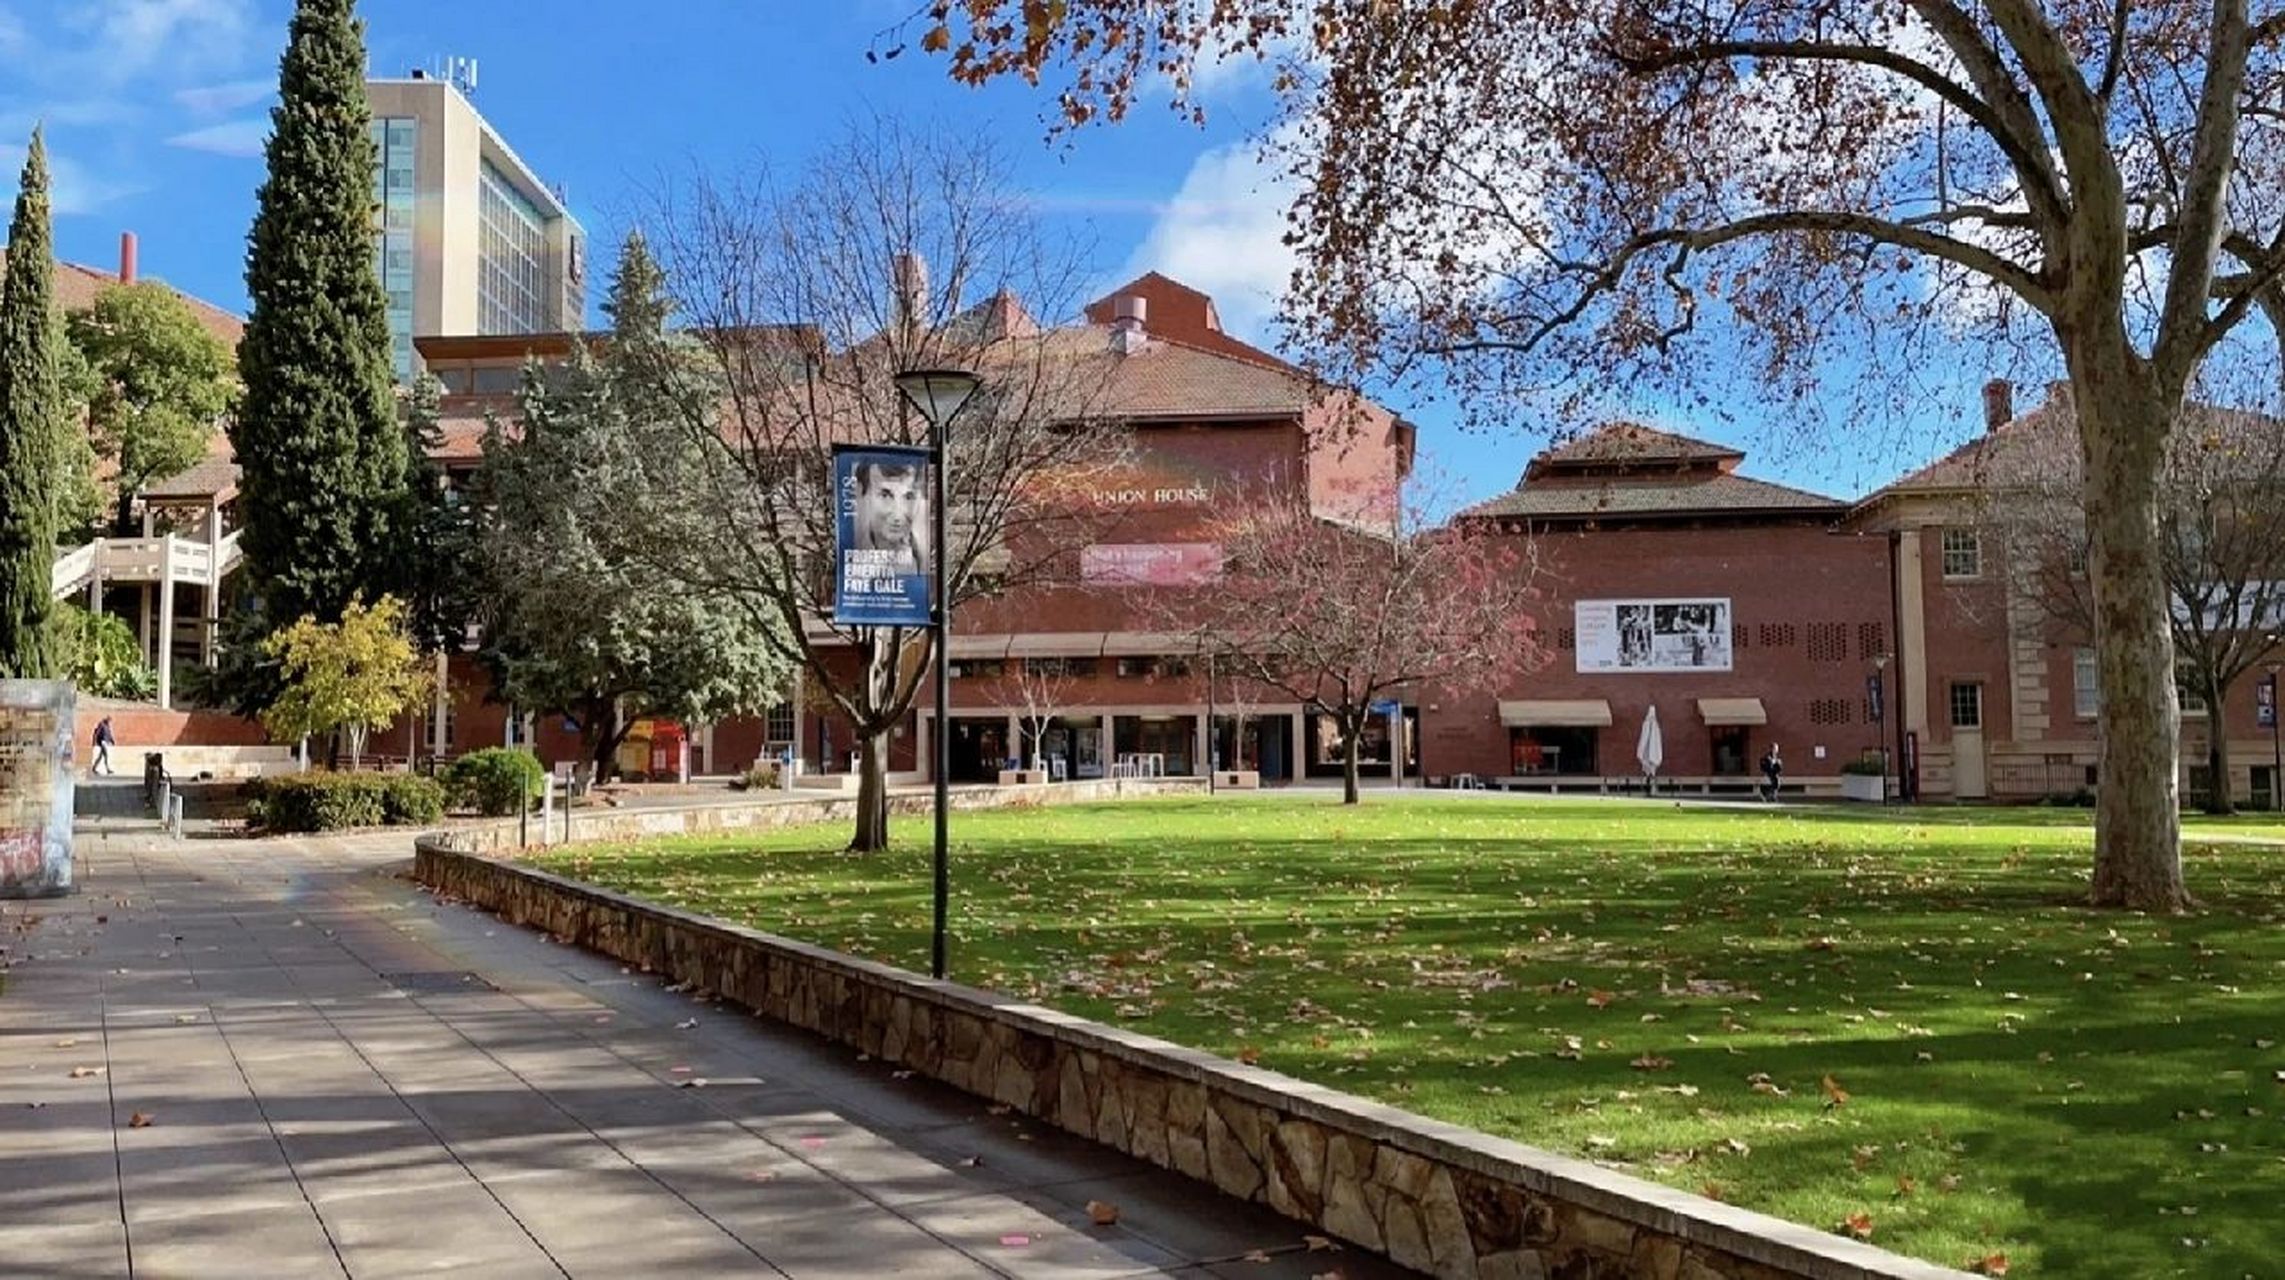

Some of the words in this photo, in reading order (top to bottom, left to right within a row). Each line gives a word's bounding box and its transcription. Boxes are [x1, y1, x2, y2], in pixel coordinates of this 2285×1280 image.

[842, 475, 858, 517] 1978
[1092, 489, 1146, 504] UNION
[1154, 488, 1208, 502] HOUSE
[844, 549, 913, 565] PROFESSOR
[874, 579, 905, 594] GALE
